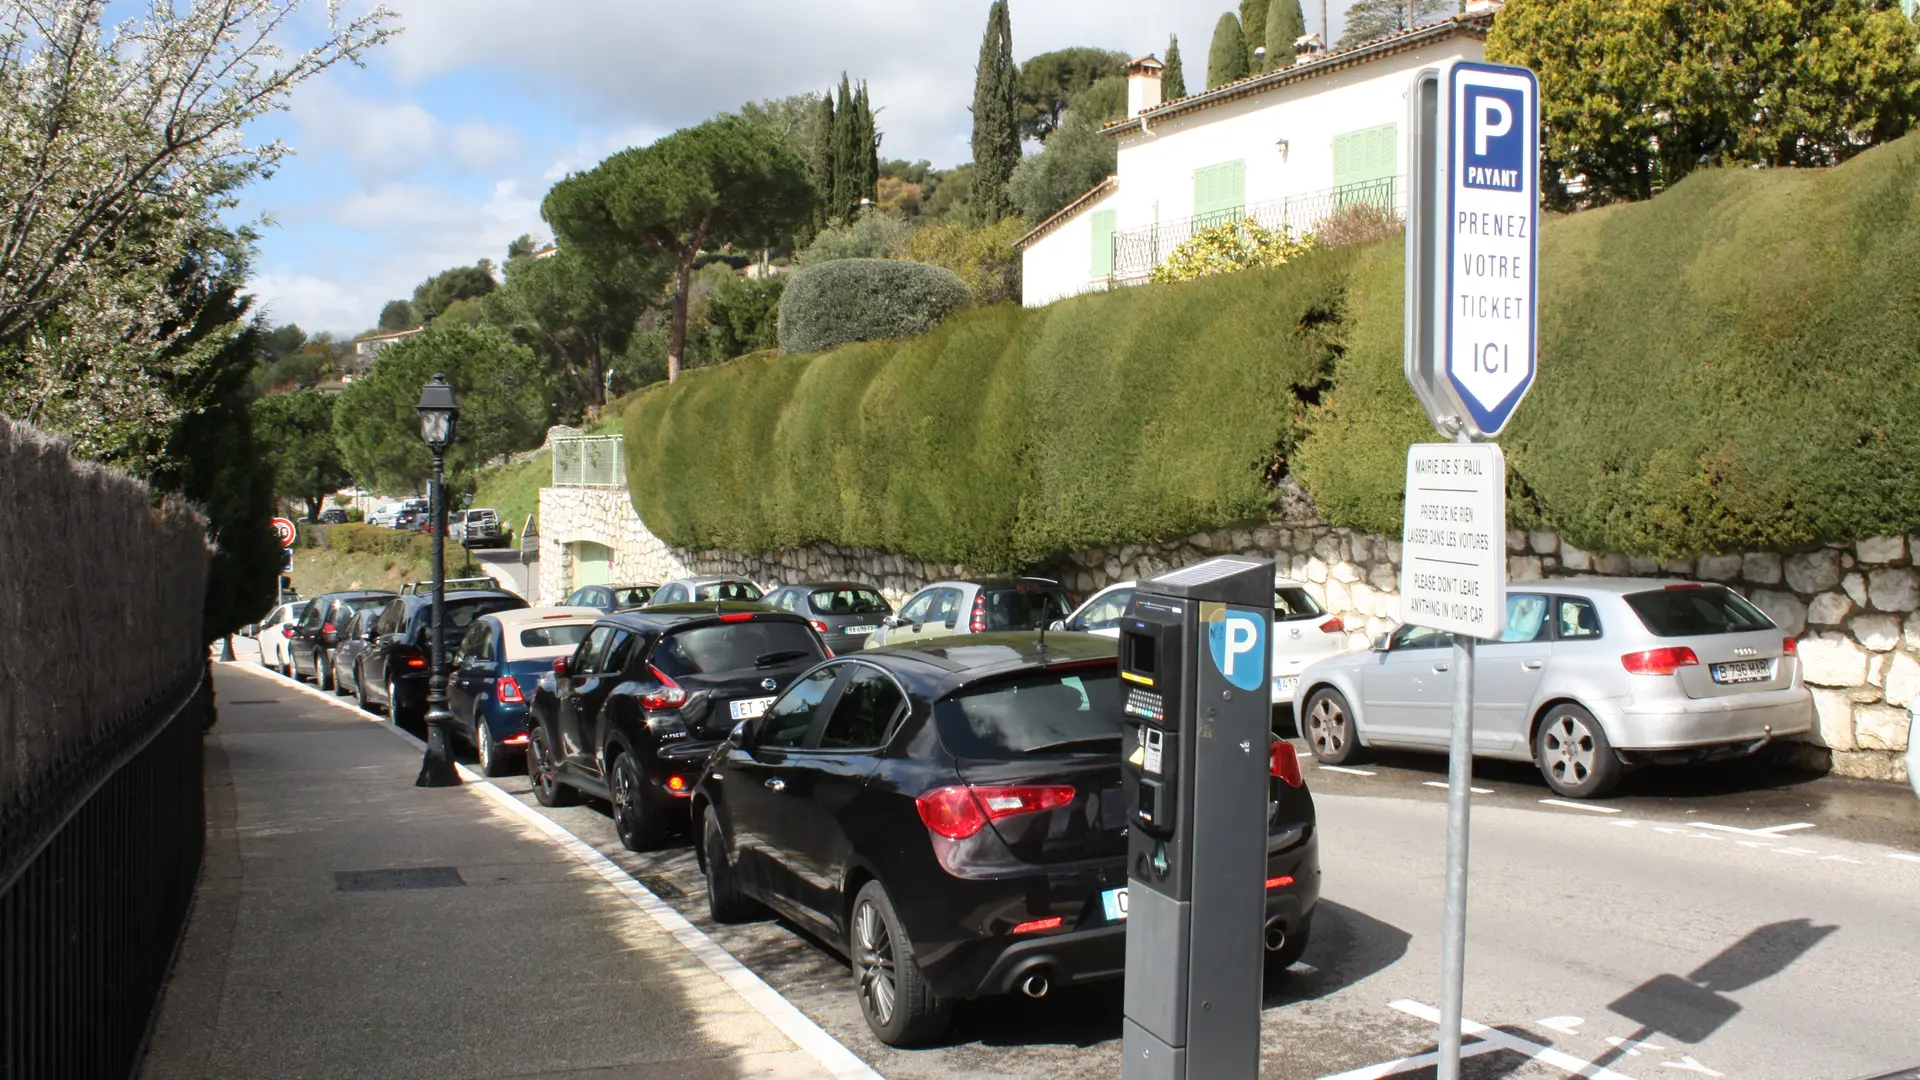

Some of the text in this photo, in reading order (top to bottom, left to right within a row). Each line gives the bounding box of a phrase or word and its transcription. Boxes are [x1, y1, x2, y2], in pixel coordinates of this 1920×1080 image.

[1475, 96, 1513, 156] P
[1468, 166, 1518, 188] PAYANT
[1458, 211, 1527, 239] PRENEZ
[1463, 253, 1521, 279] VOTRE
[1461, 295, 1523, 320] TICKET
[1474, 342, 1509, 374] ICI
[1415, 459, 1439, 475] MAIRIE
[1441, 459, 1451, 475] DE
[1463, 459, 1483, 476] PAUL
[1440, 505, 1448, 521] DE
[1449, 506, 1458, 522] NE
[1459, 506, 1474, 522] RIEN
[1407, 527, 1489, 551] LAISSER DANS LES VOITURES
[1413, 573, 1480, 598] PLEASE DON'T LEAVE
[1410, 597, 1484, 624] ANYTHING IN YOUR CAR
[1224, 618, 1258, 675] P
[1719, 661, 1768, 679] B 796 MAR
[740, 701, 753, 715] ET
